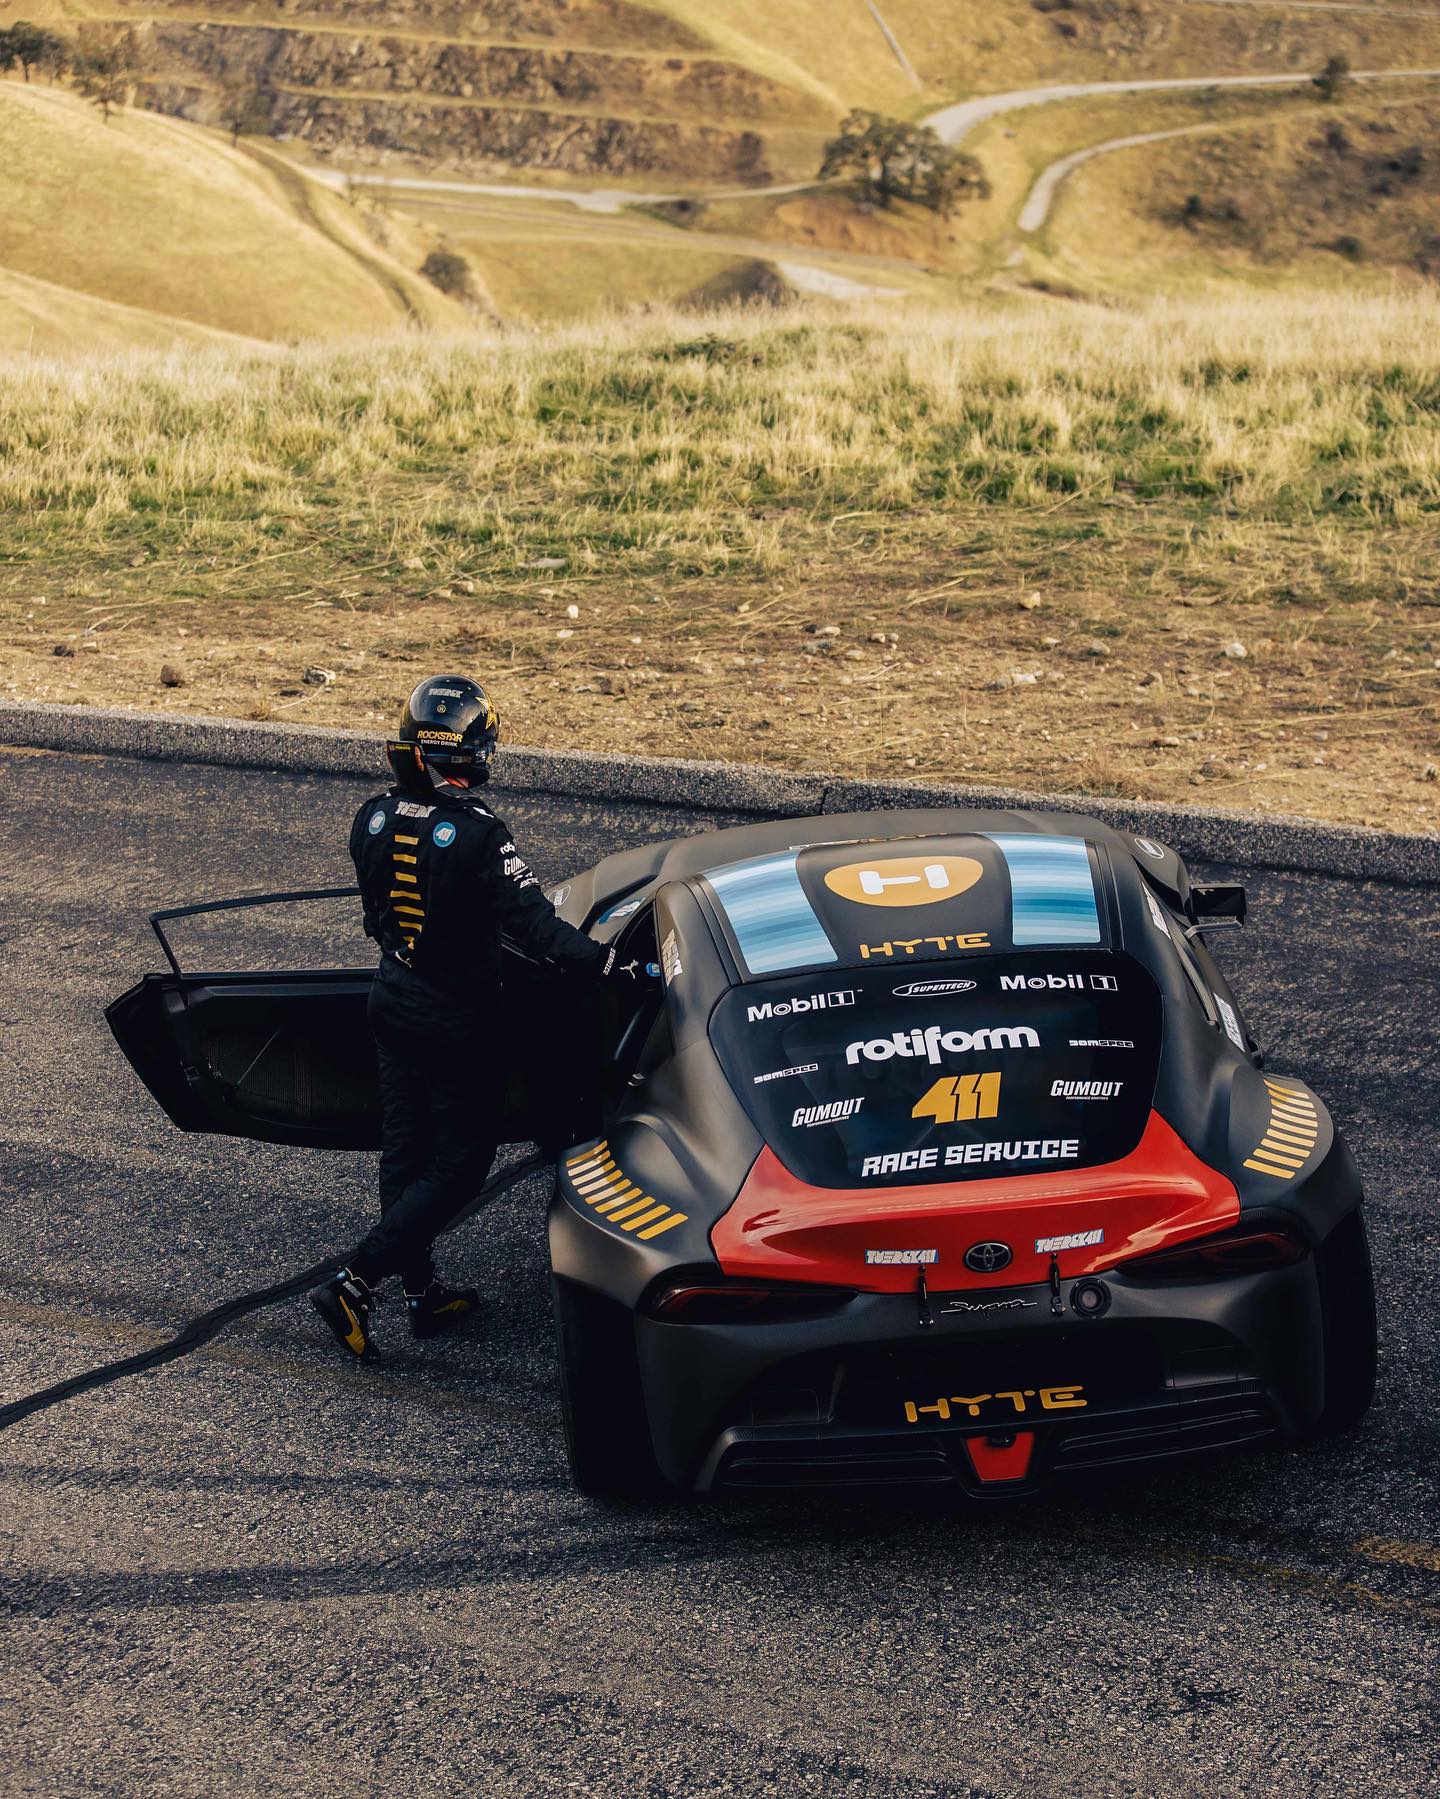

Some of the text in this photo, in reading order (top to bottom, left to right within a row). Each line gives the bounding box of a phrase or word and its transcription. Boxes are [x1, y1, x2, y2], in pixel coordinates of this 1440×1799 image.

[417, 731, 463, 742] ROCKSTAR
[859, 932, 992, 959] HYTE
[913, 982, 971, 993] SUPERTECH
[1000, 974, 1084, 990] Mobil
[747, 993, 826, 1022] Mobil
[845, 1026, 1040, 1065] rotiform
[911, 1071, 1001, 1124] 411
[1050, 1080, 1124, 1096] GUMOUT
[792, 1097, 865, 1128] GUMOUT
[861, 1139, 1079, 1177] RACE SERVICE
[904, 1385, 1088, 1423] HYTE
